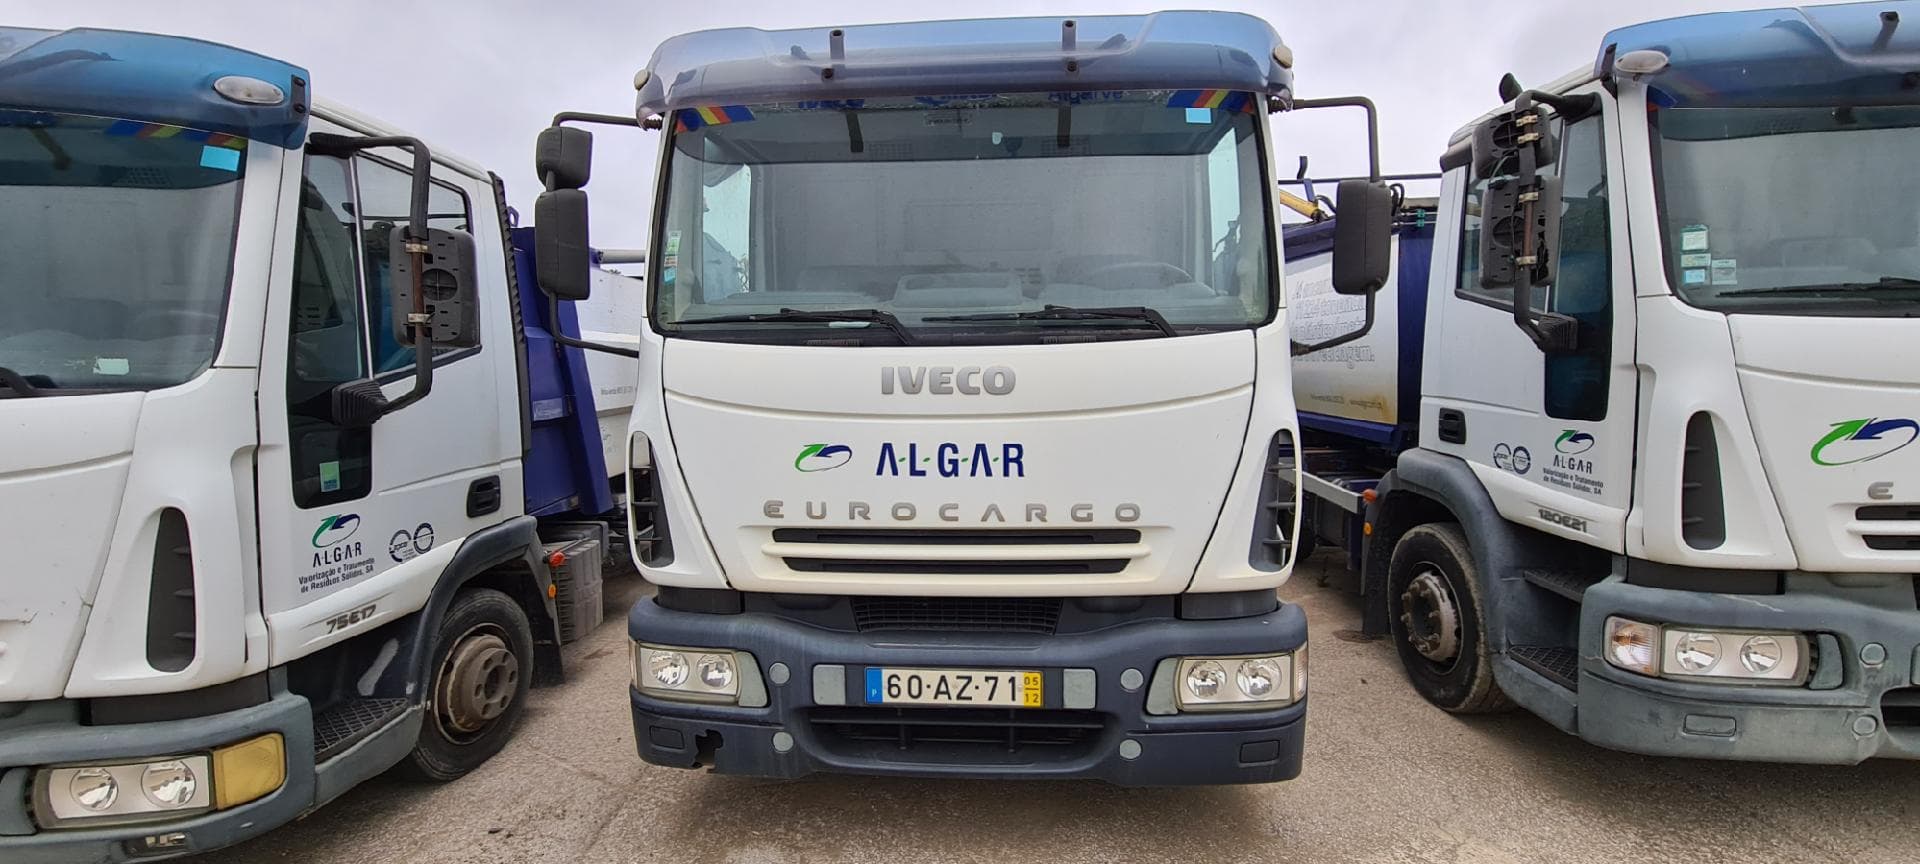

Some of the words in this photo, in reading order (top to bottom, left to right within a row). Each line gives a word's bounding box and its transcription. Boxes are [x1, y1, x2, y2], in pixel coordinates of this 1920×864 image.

[880, 365, 1016, 396] IVECO
[763, 499, 1142, 523] EUROCARGO
[1538, 508, 1588, 533] 120E21
[365, 564, 374, 574] SA
[325, 604, 377, 634] 75E17
[1023, 676, 1039, 686] 05
[1024, 693, 1039, 704] 12
